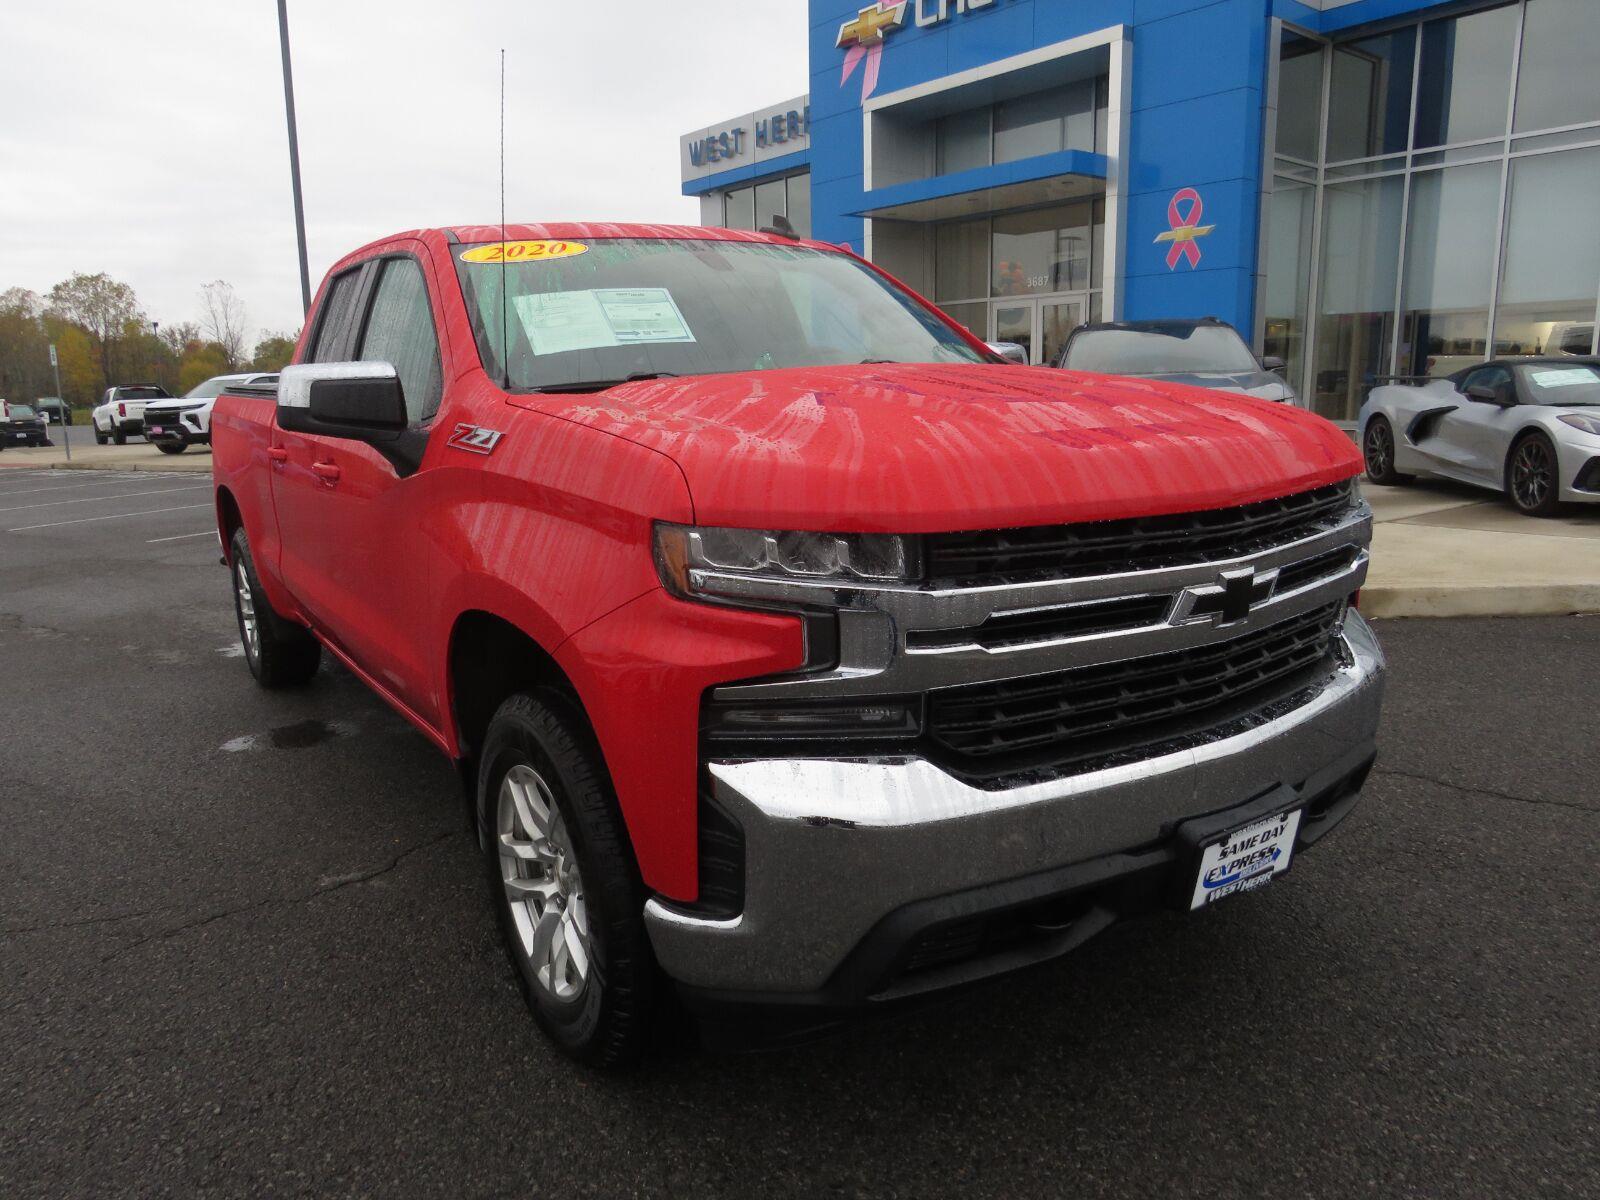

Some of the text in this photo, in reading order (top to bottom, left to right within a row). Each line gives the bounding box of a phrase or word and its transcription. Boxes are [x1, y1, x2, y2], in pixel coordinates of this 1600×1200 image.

[688, 127, 743, 167] WEST
[484, 243, 568, 261] 2020
[1027, 275, 1049, 288] 3687
[447, 423, 502, 455] Z71
[1218, 834, 1259, 861] SAME
[1259, 822, 1288, 844] DAY
[1209, 843, 1277, 882] EXPRESS
